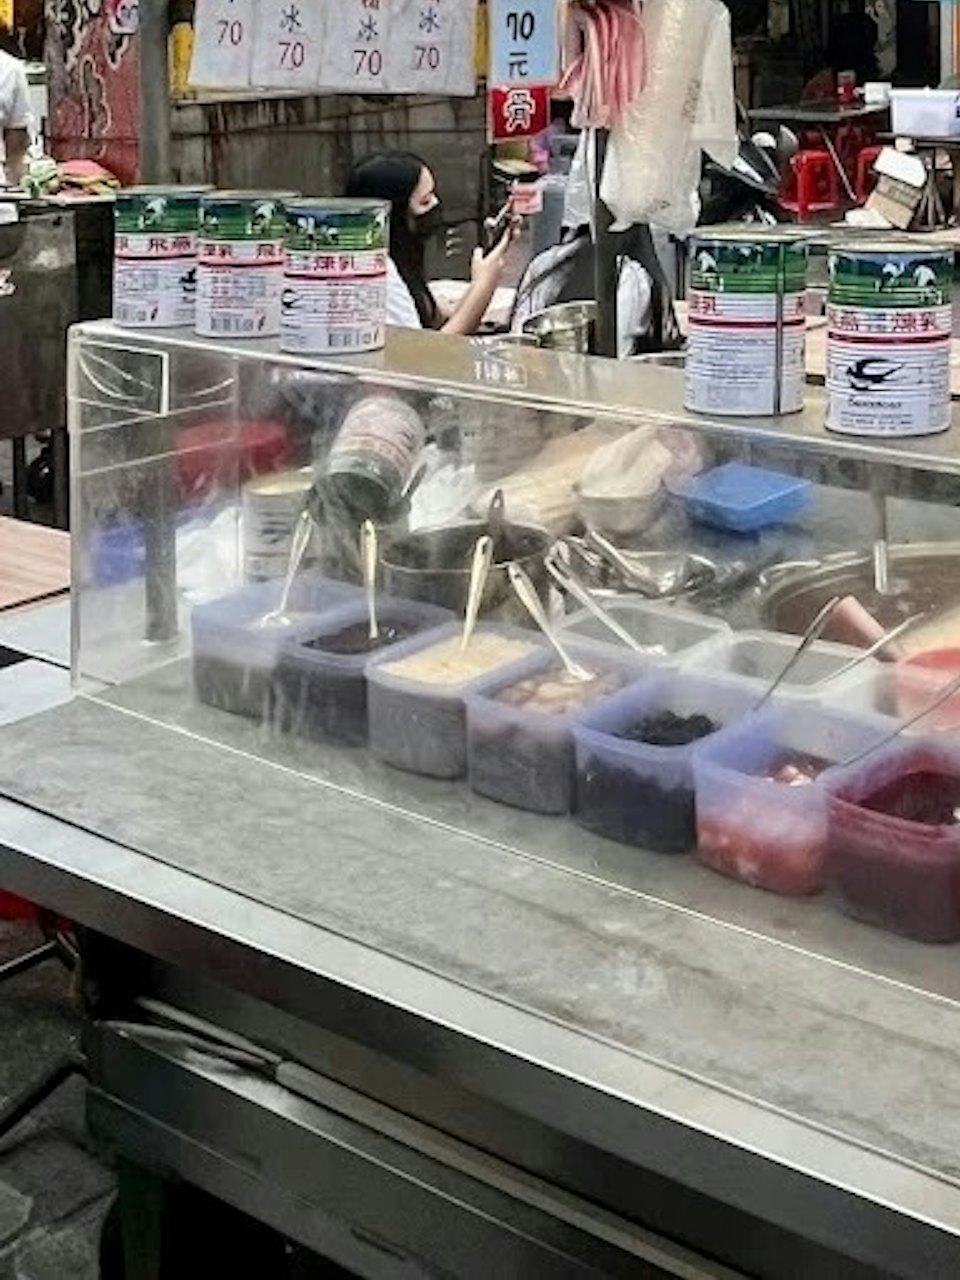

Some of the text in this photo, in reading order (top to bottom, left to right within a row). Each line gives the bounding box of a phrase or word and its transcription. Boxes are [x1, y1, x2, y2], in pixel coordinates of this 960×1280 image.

[217, 20, 243, 47] 70
[277, 42, 305, 69] 70
[353, 50, 383, 76] 70
[414, 46, 441, 70] 70
[502, 89, 536, 131] 骨
